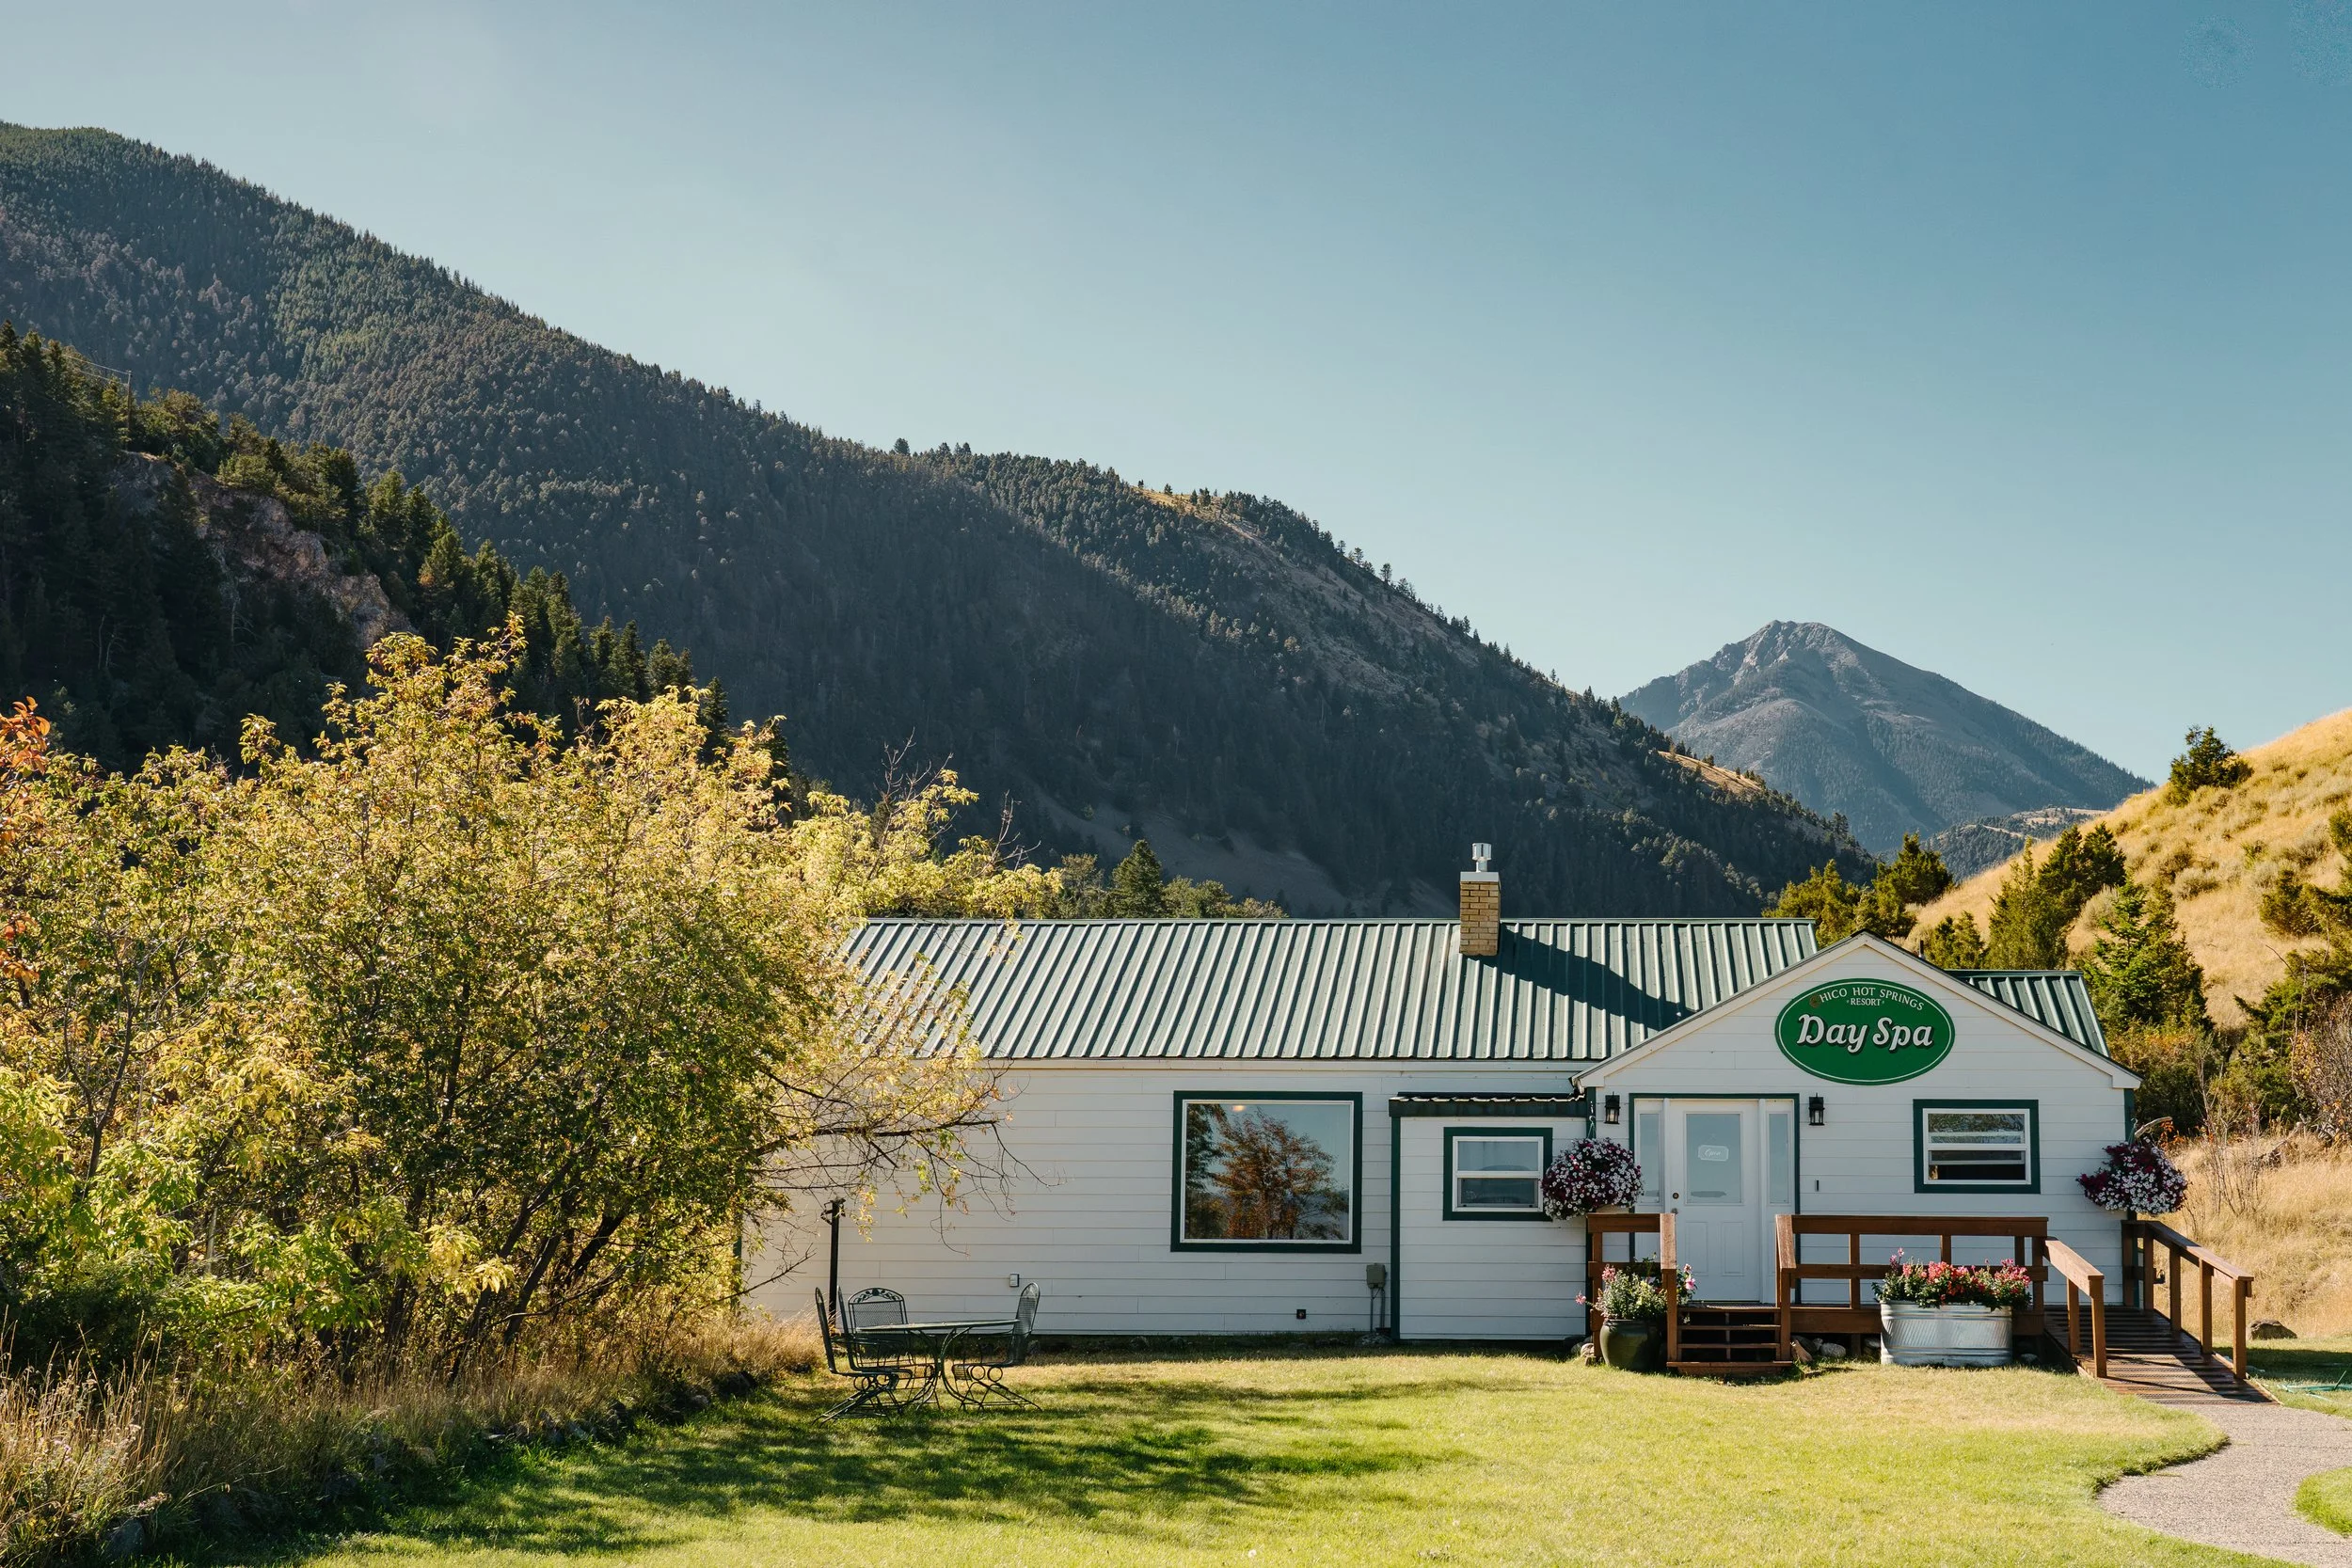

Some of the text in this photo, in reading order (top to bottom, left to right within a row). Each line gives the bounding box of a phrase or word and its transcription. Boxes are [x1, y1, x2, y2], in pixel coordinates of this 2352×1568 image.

[1809, 987, 1925, 1011] HICO HOT SPRINGS
[1850, 998, 1882, 1006] RESORT
[1797, 1014, 1933, 1053] Day Spa
